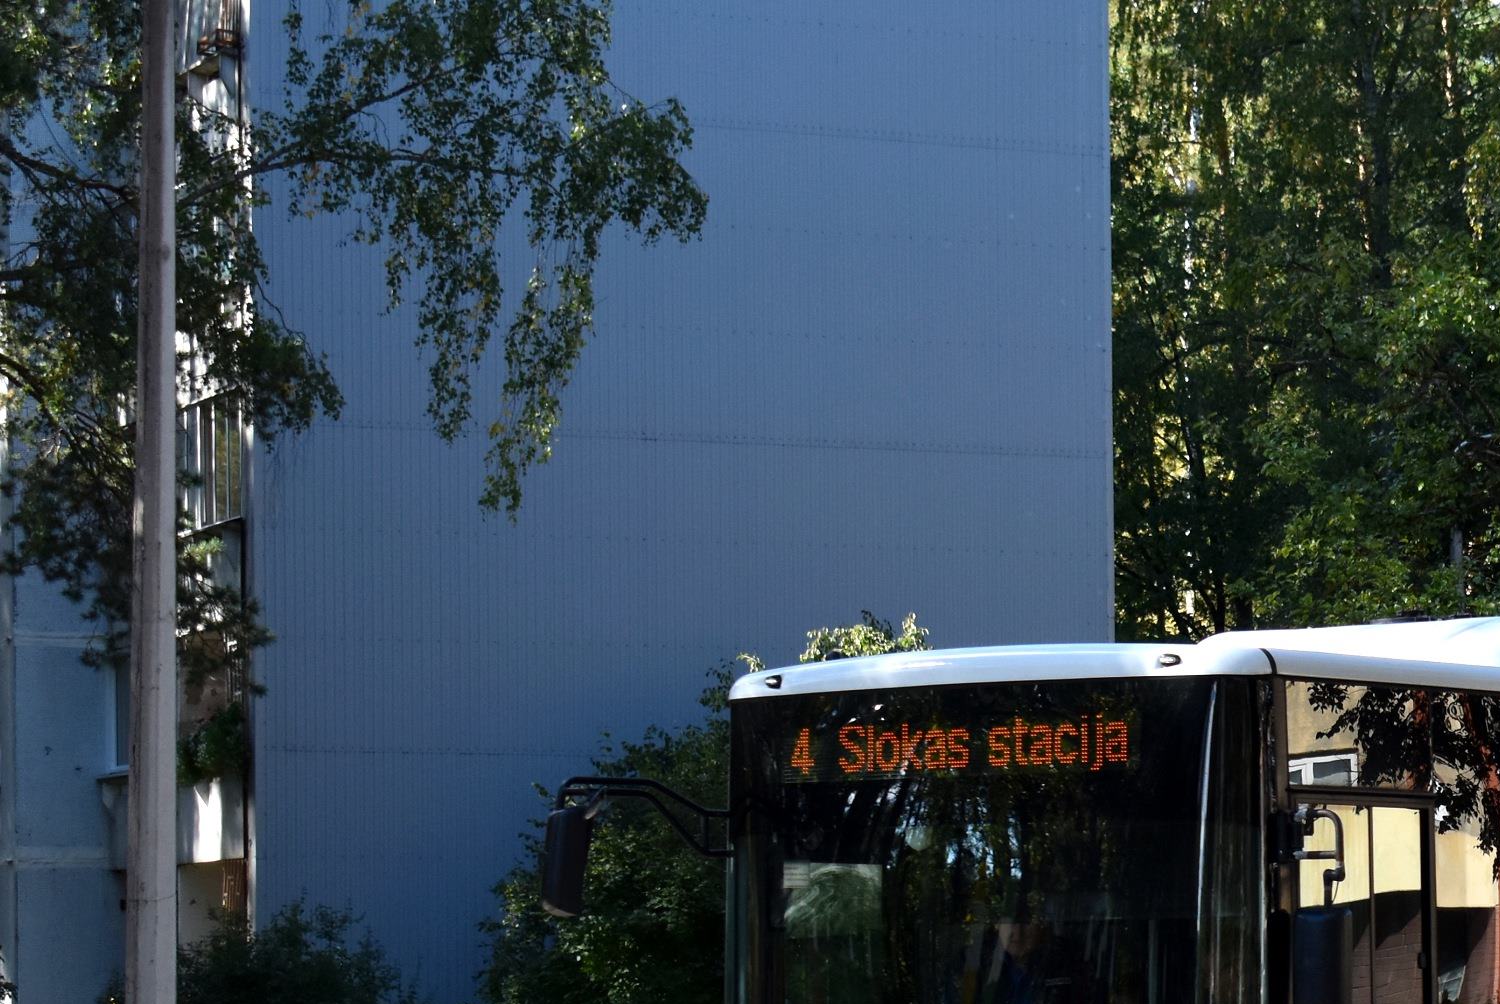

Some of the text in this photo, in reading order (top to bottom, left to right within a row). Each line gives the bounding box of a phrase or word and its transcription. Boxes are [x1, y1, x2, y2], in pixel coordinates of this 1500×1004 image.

[790, 712, 1129, 775] 4 Slokas stacija
